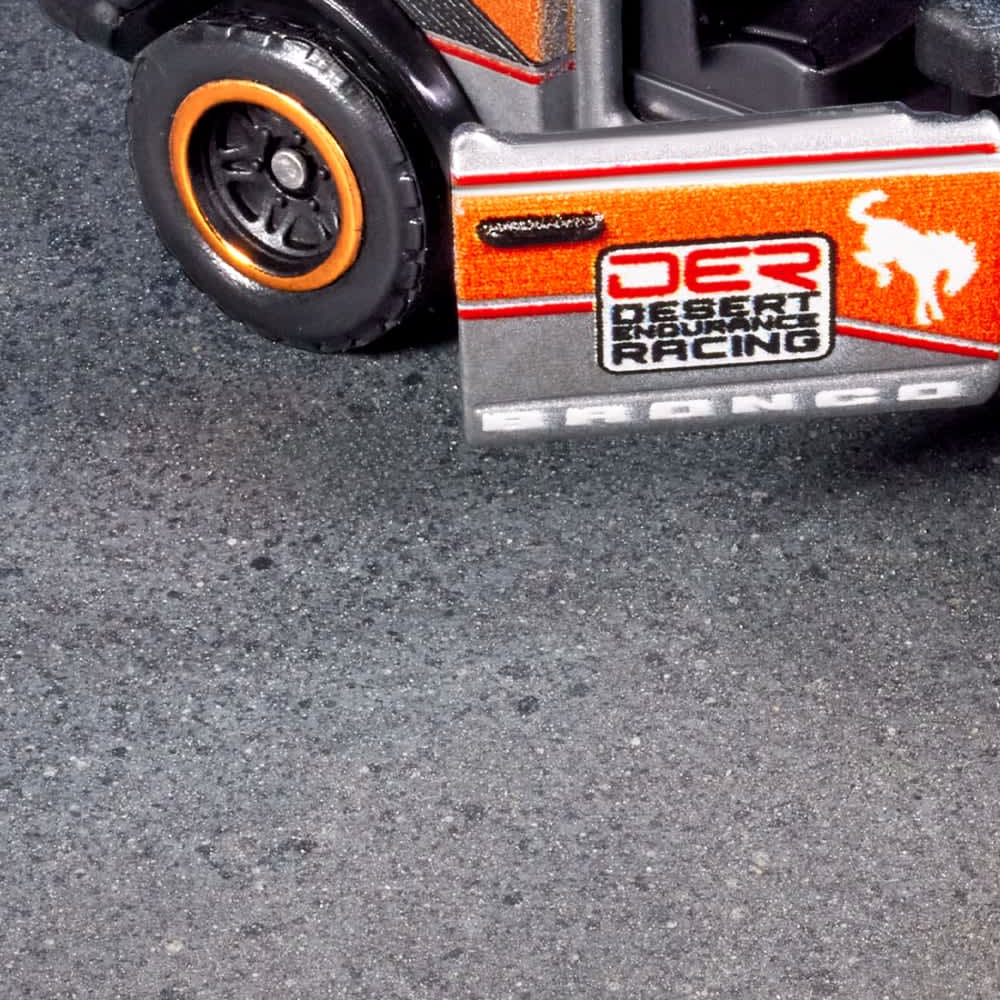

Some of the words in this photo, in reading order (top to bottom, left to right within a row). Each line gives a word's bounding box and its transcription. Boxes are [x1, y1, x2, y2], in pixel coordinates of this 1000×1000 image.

[608, 243, 821, 299] DER
[612, 291, 821, 325] DESERT
[612, 313, 819, 341] ENDURANCE
[612, 330, 820, 365] RACING
[482, 380, 961, 431] BRONCO
